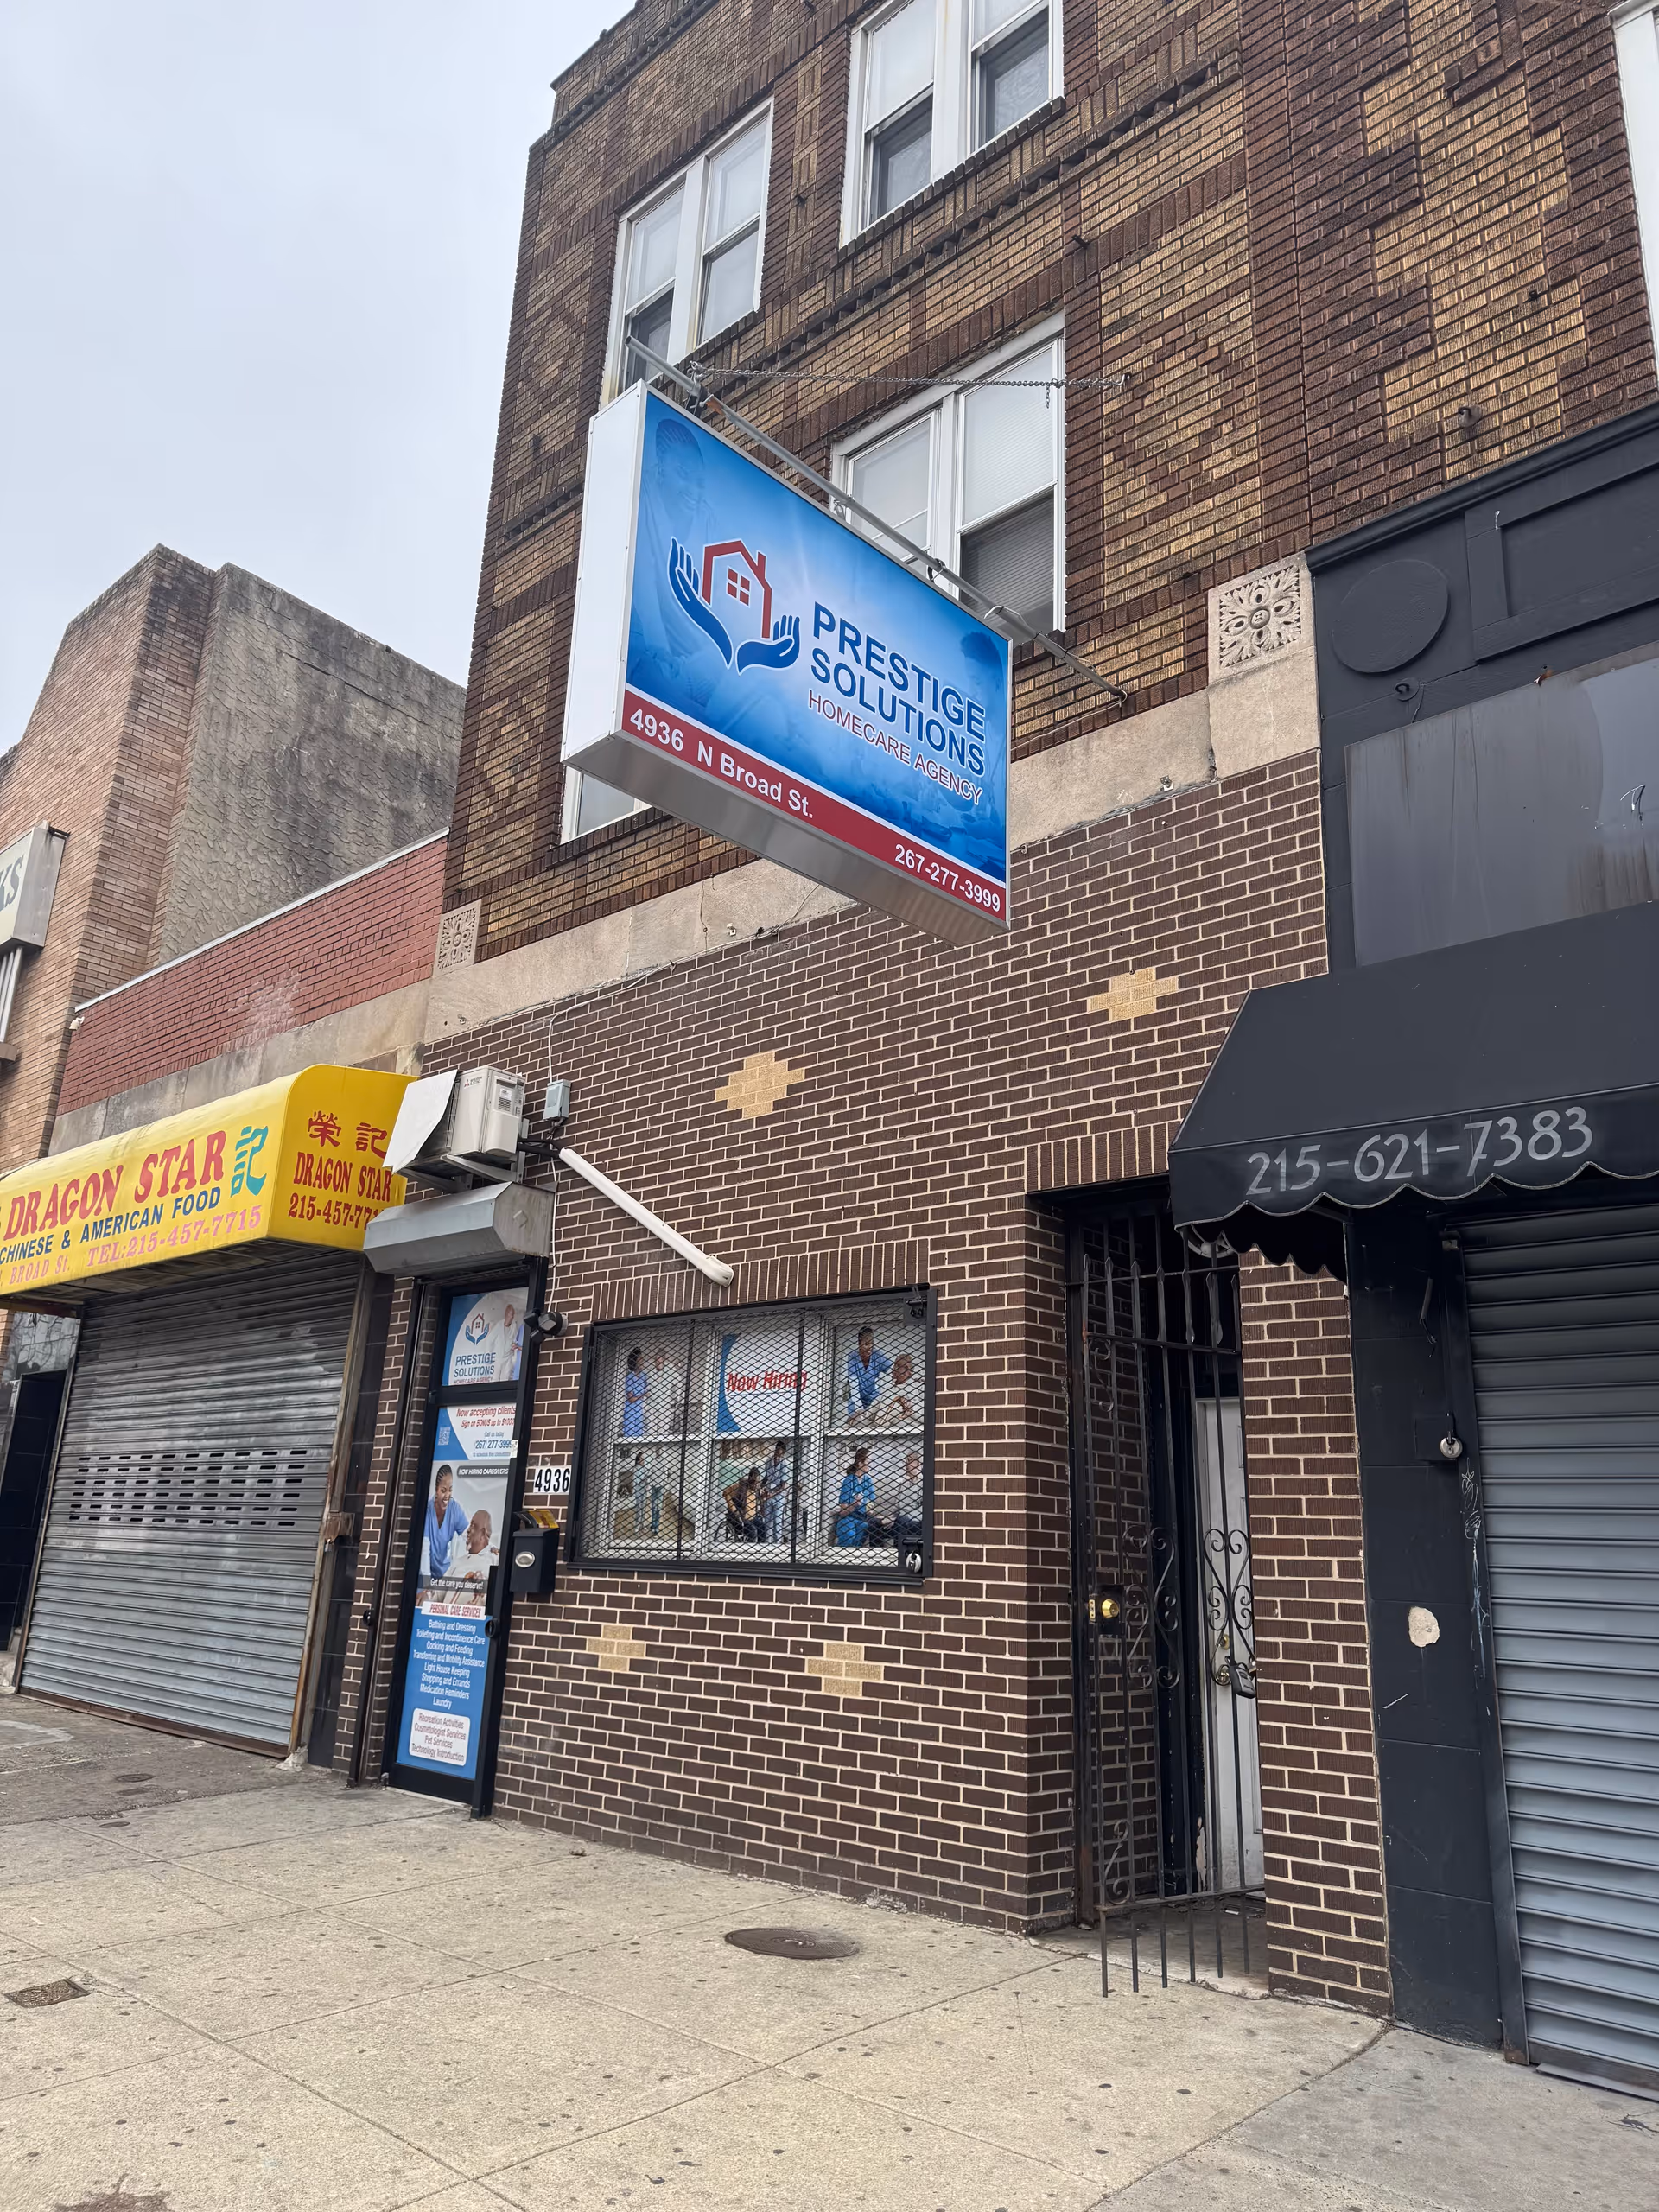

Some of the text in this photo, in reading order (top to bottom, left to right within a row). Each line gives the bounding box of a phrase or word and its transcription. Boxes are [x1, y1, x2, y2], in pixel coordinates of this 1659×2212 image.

[814, 601, 985, 741] PRESTIGE
[810, 647, 985, 776] SOLUTIONS
[809, 690, 983, 804] HOMECARE AGENCY
[630, 709, 813, 818] 4936 N Broad St.
[895, 843, 1001, 912] 267-277-3999
[1246, 1107, 1593, 1196] 215-621-7383
[230, 1126, 268, 1198] 記
[3, 1130, 226, 1241] DRAGON STAR
[293, 1152, 392, 1202] DRAGON STAR
[0, 1186, 221, 1264] CHINESE & AMERICAN FOOD
[9, 1259, 49, 1285] BROAD
[455, 1352, 496, 1366] PRESTIGE
[454, 1365, 495, 1377] SOLUTIONS
[727, 1372, 759, 1392] Now
[456, 1406, 517, 1418] Now accepting clients
[534, 1468, 570, 1493] 4936
[455, 1580, 464, 1589] you
[429, 1604, 481, 1618] PERSONAL CARE SERVICES
[429, 1619, 476, 1634] Bathing and Dressing
[416, 1629, 485, 1645] Toileting and Incontinence Care
[426, 1641, 473, 1656] Cooking and Feeding
[414, 1649, 437, 1662] Transferring
[446, 1654, 461, 1666] Mobility
[462, 1656, 485, 1668] Assistance
[424, 1662, 470, 1678] Light House Keeping
[422, 1673, 470, 1688] Shopping and Errands
[420, 1683, 470, 1700] Medication Reminders
[433, 1697, 452, 1710] Laundry
[418, 1713, 464, 1729] Recreation Activities
[414, 1723, 467, 1740] Cosmetologist Services
[411, 1743, 436, 1758] Technology
[424, 1735, 453, 1749] Pet Services
